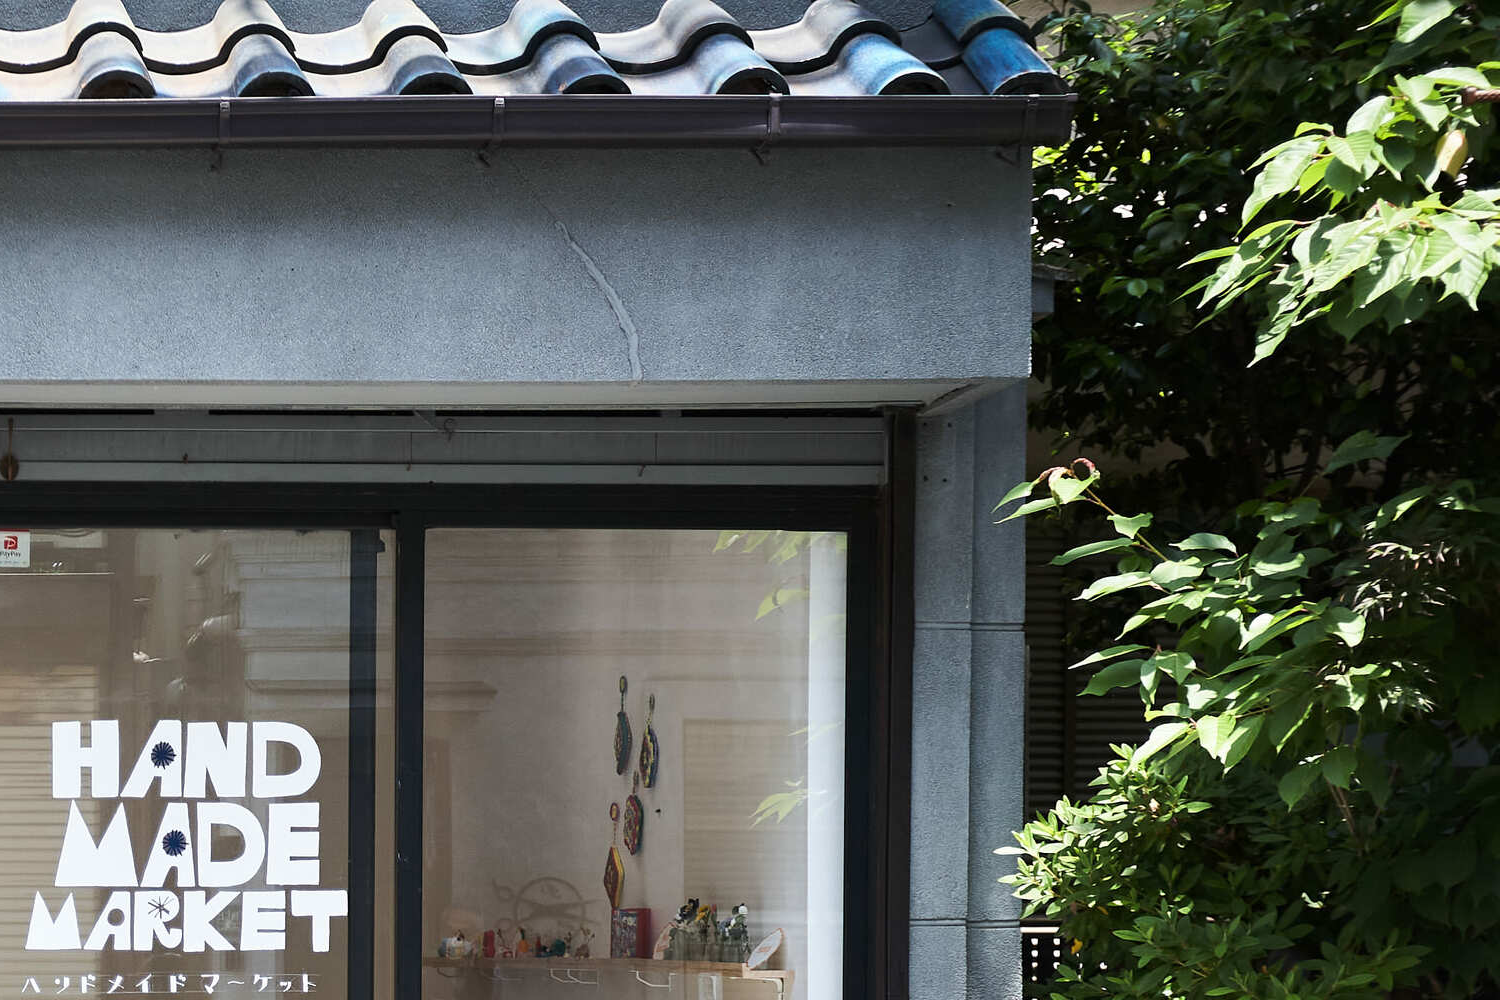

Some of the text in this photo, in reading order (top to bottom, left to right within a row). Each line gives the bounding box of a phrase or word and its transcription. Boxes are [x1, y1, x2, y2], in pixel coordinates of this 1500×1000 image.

[52, 719, 322, 798] HAND
[54, 799, 320, 887] MADE
[25, 889, 348, 952] MARKET
